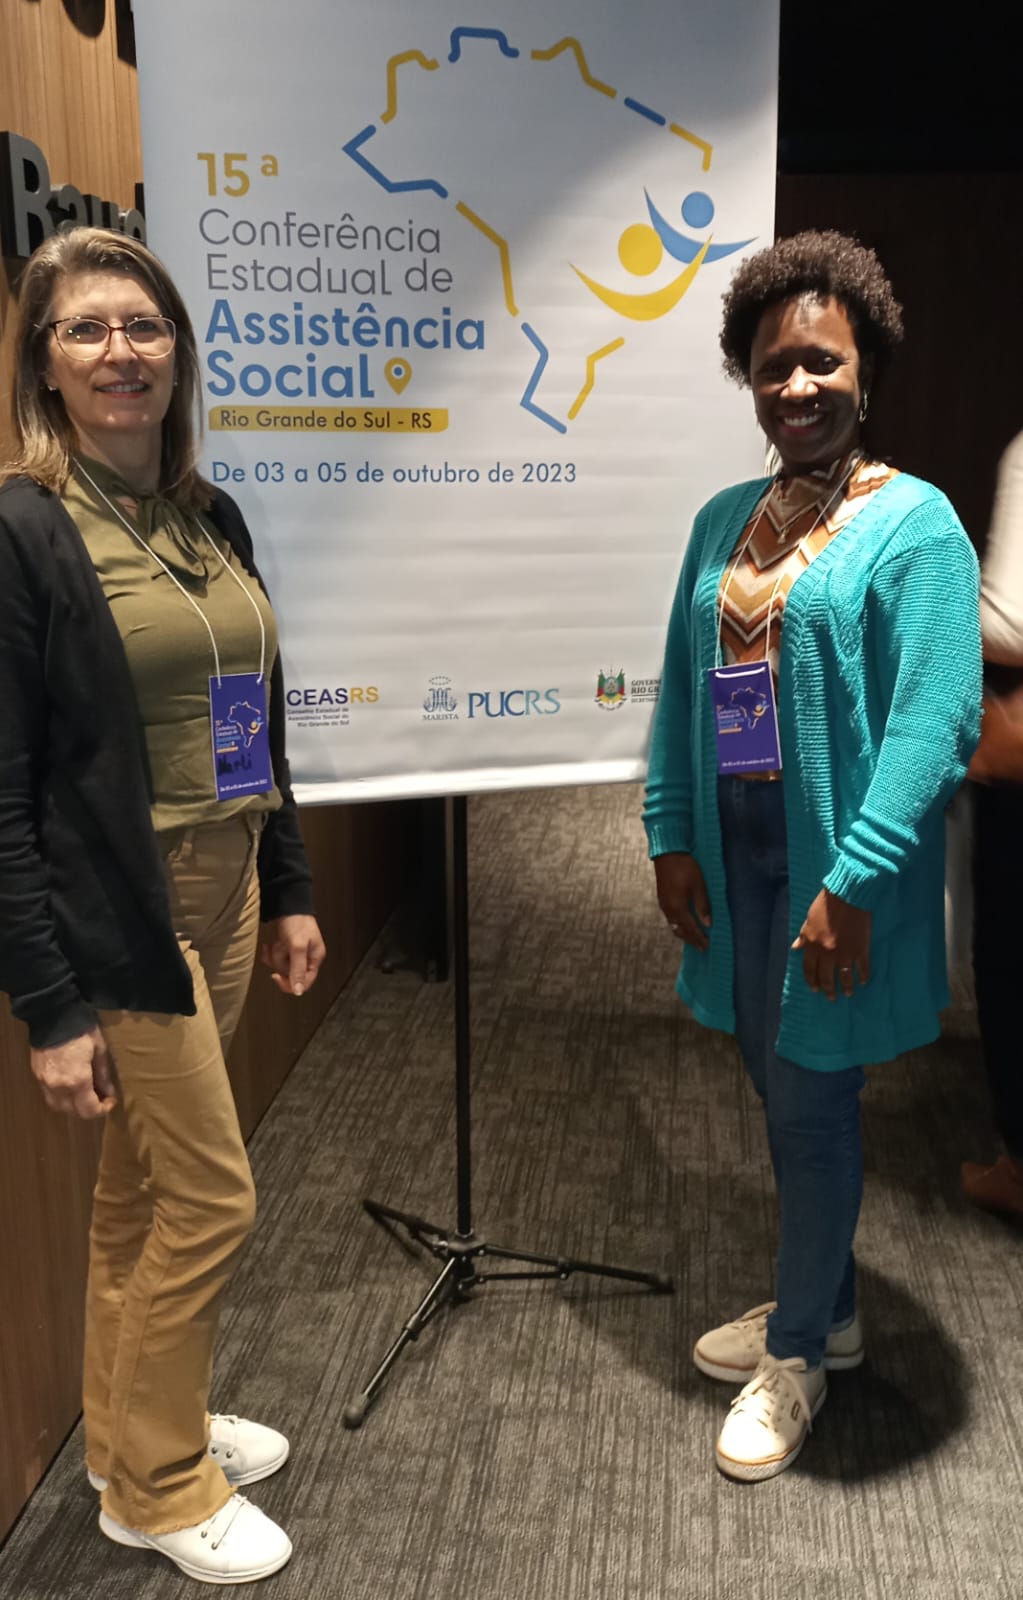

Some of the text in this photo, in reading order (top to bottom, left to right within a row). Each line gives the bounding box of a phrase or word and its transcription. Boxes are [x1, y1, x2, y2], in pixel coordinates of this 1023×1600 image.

[199, 208, 441, 254] Conferência
[207, 254, 453, 295] Estadual de
[204, 299, 485, 350] Assistência
[206, 350, 375, 398] Social
[220, 410, 249, 427] Rio
[256, 410, 327, 428] Grande
[334, 411, 357, 428] do
[363, 411, 391, 429] Sul
[411, 412, 432, 429] RS
[212, 461, 577, 483] De 03 a 05 de outubro de 2023
[286, 686, 379, 707] CEASRS
[468, 688, 561, 718] PUCRS
[631, 686, 646, 694] RIO
[423, 713, 459, 721] MARISTA
